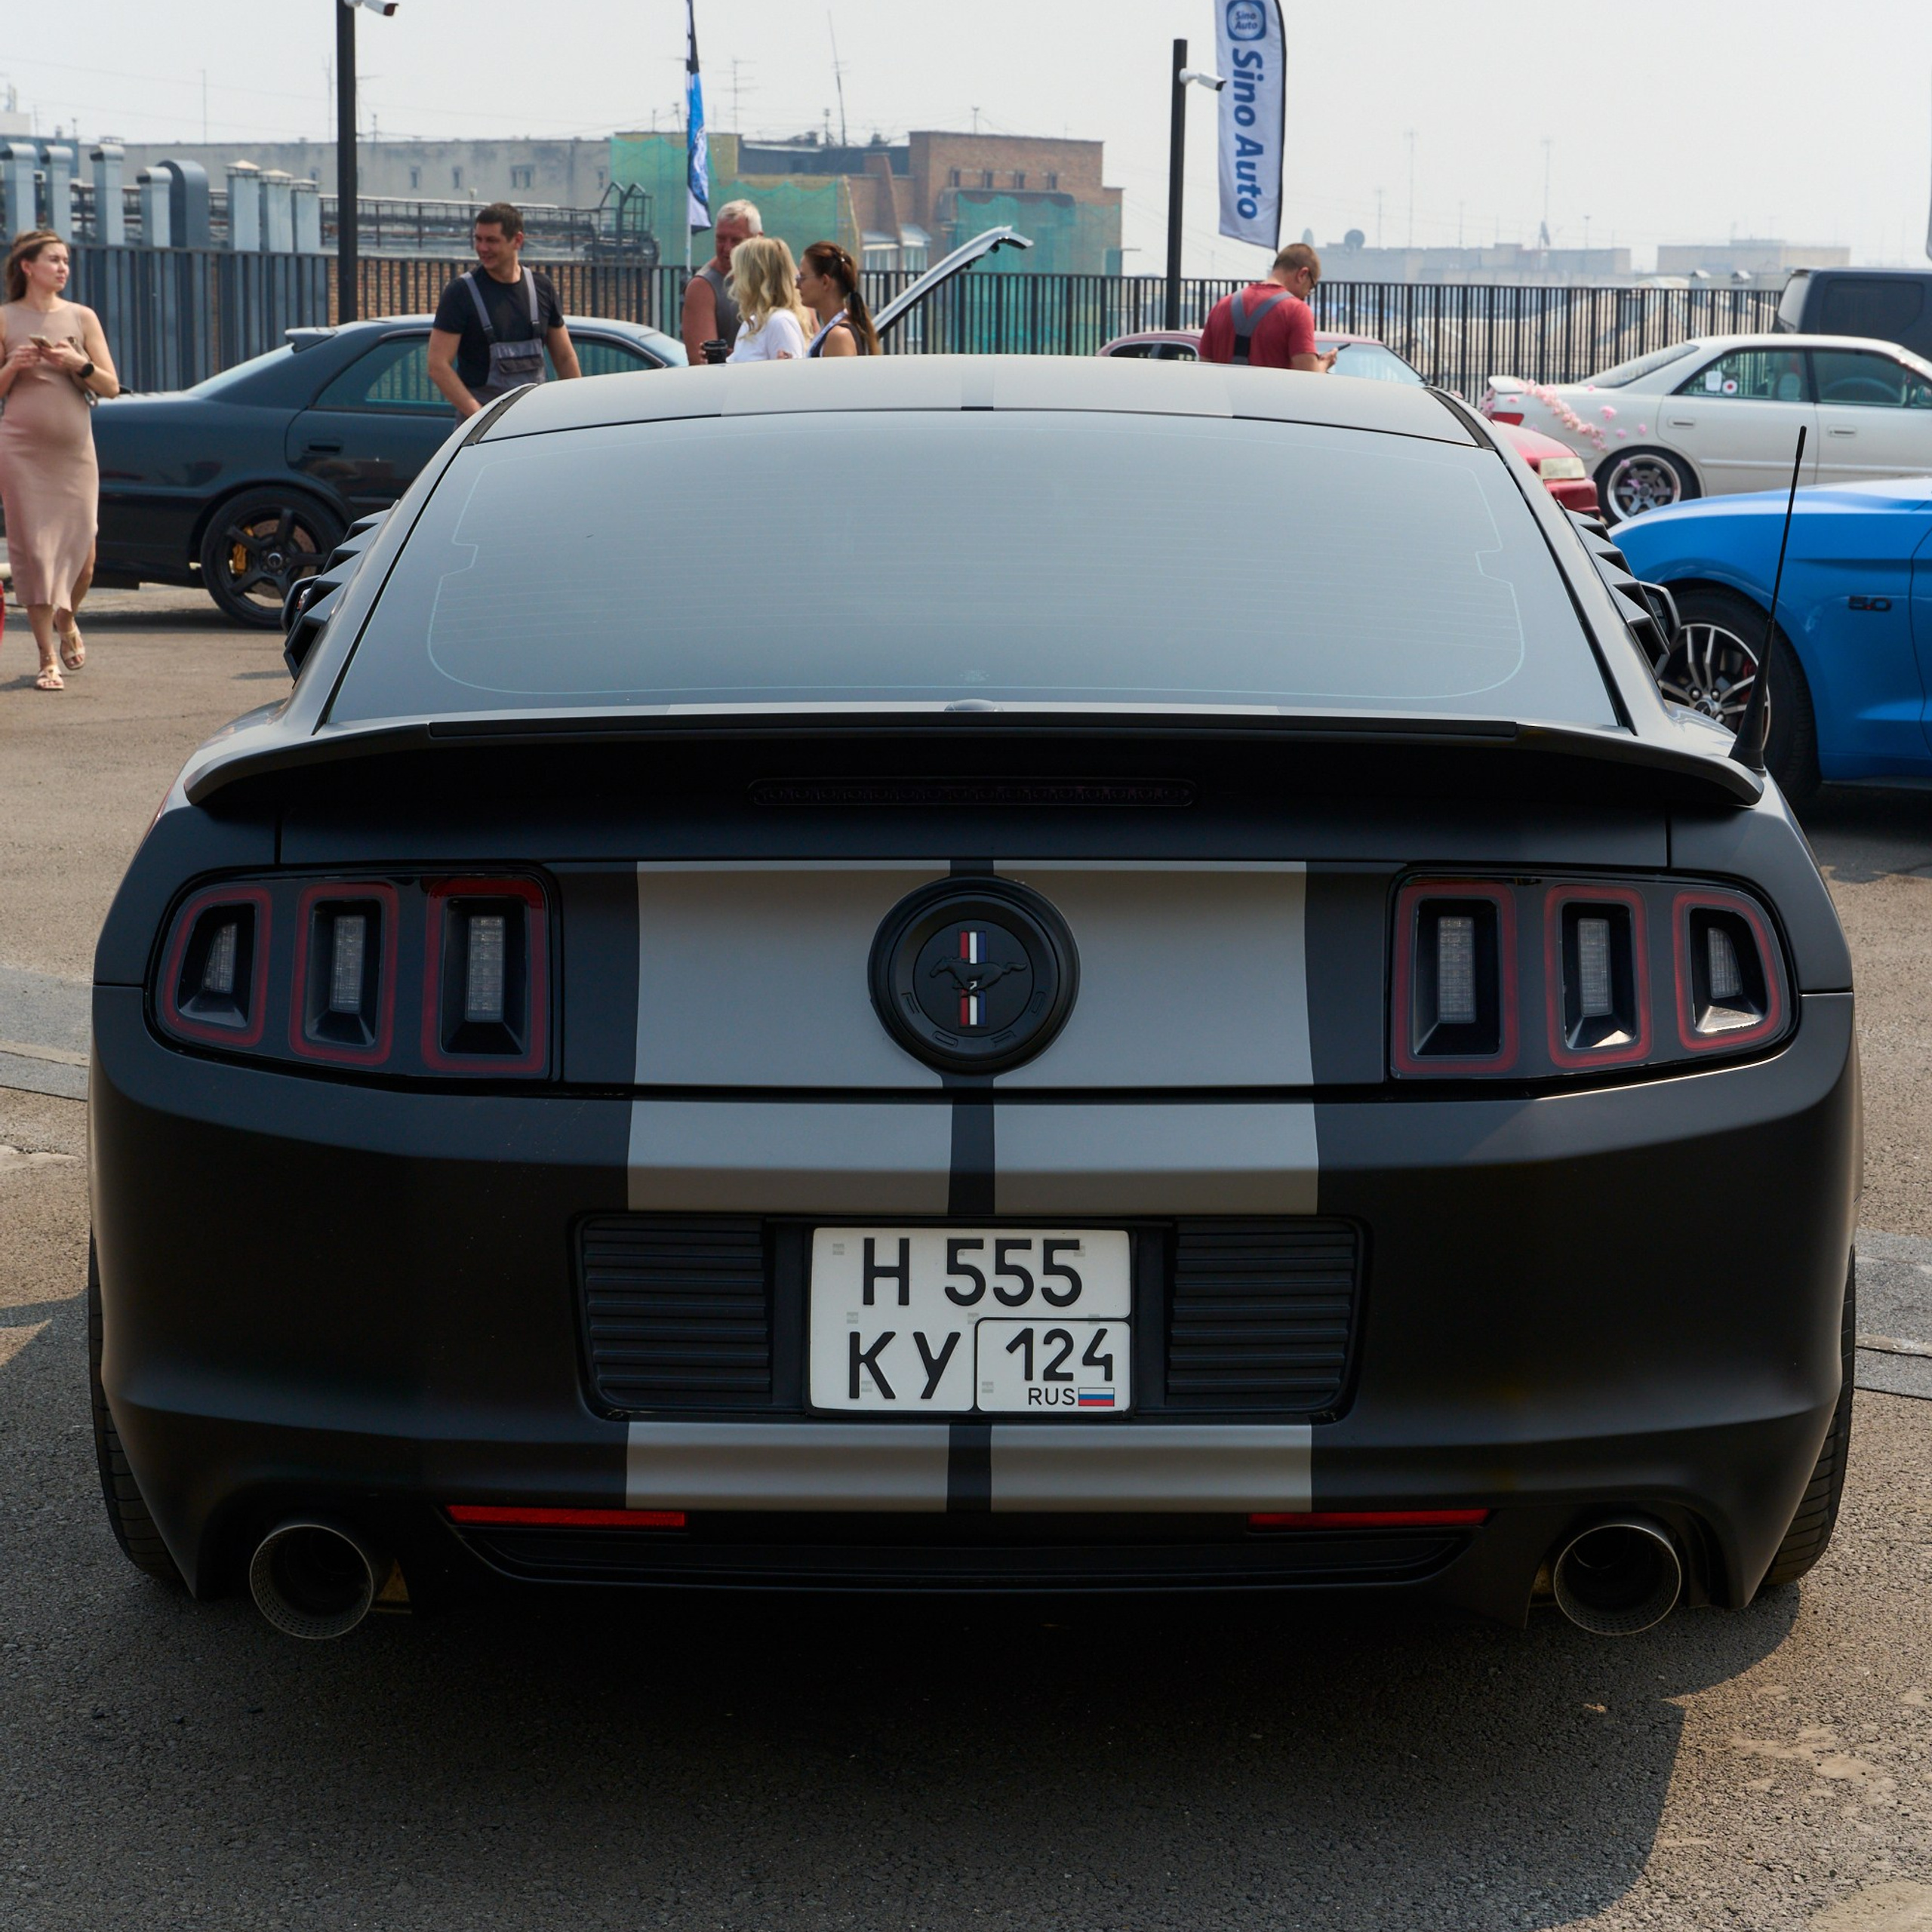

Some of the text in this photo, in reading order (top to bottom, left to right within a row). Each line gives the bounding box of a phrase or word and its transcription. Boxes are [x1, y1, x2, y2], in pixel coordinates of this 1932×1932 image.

[1235, 11, 1257, 20] Sino
[1235, 21, 1258, 30] Auto
[1232, 48, 1264, 220] Sino Auto
[944, 1238, 1082, 1307] 555
[1005, 1327, 1113, 1381] 124
[1028, 1387, 1075, 1406] RUS
